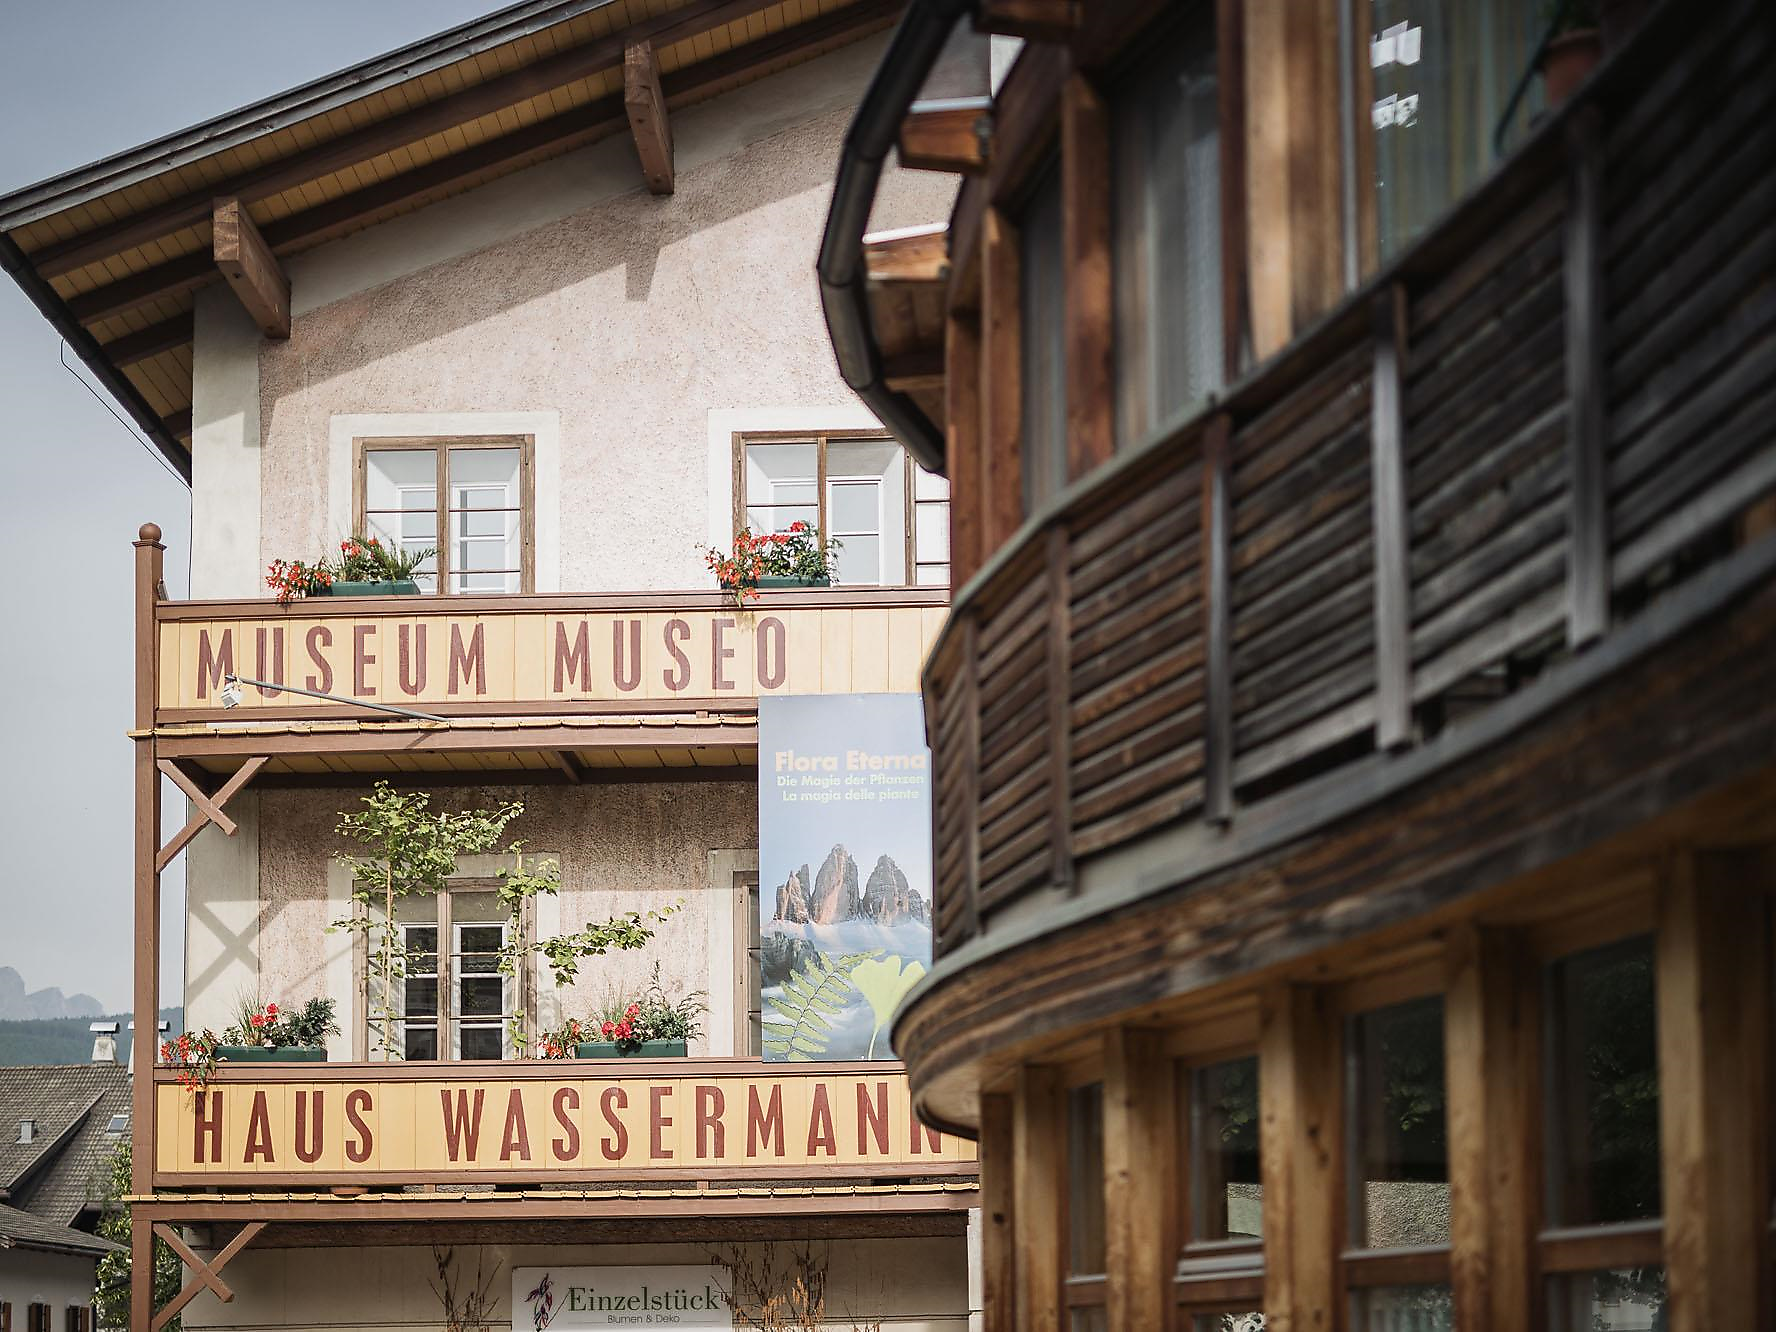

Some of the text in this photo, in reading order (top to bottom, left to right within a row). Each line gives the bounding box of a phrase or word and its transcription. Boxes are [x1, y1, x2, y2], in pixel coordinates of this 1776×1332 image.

[196, 616, 787, 700] MUSEUM MUSEO
[775, 750, 927, 772] Flora Eterna
[777, 774, 925, 788] Die Magie der Pflanzen
[783, 789, 920, 803] La magia delle piante
[193, 1089, 373, 1164] HAUS
[567, 1285, 721, 1312] Einzelstück
[607, 1313, 681, 1324] Blumen & Deko
